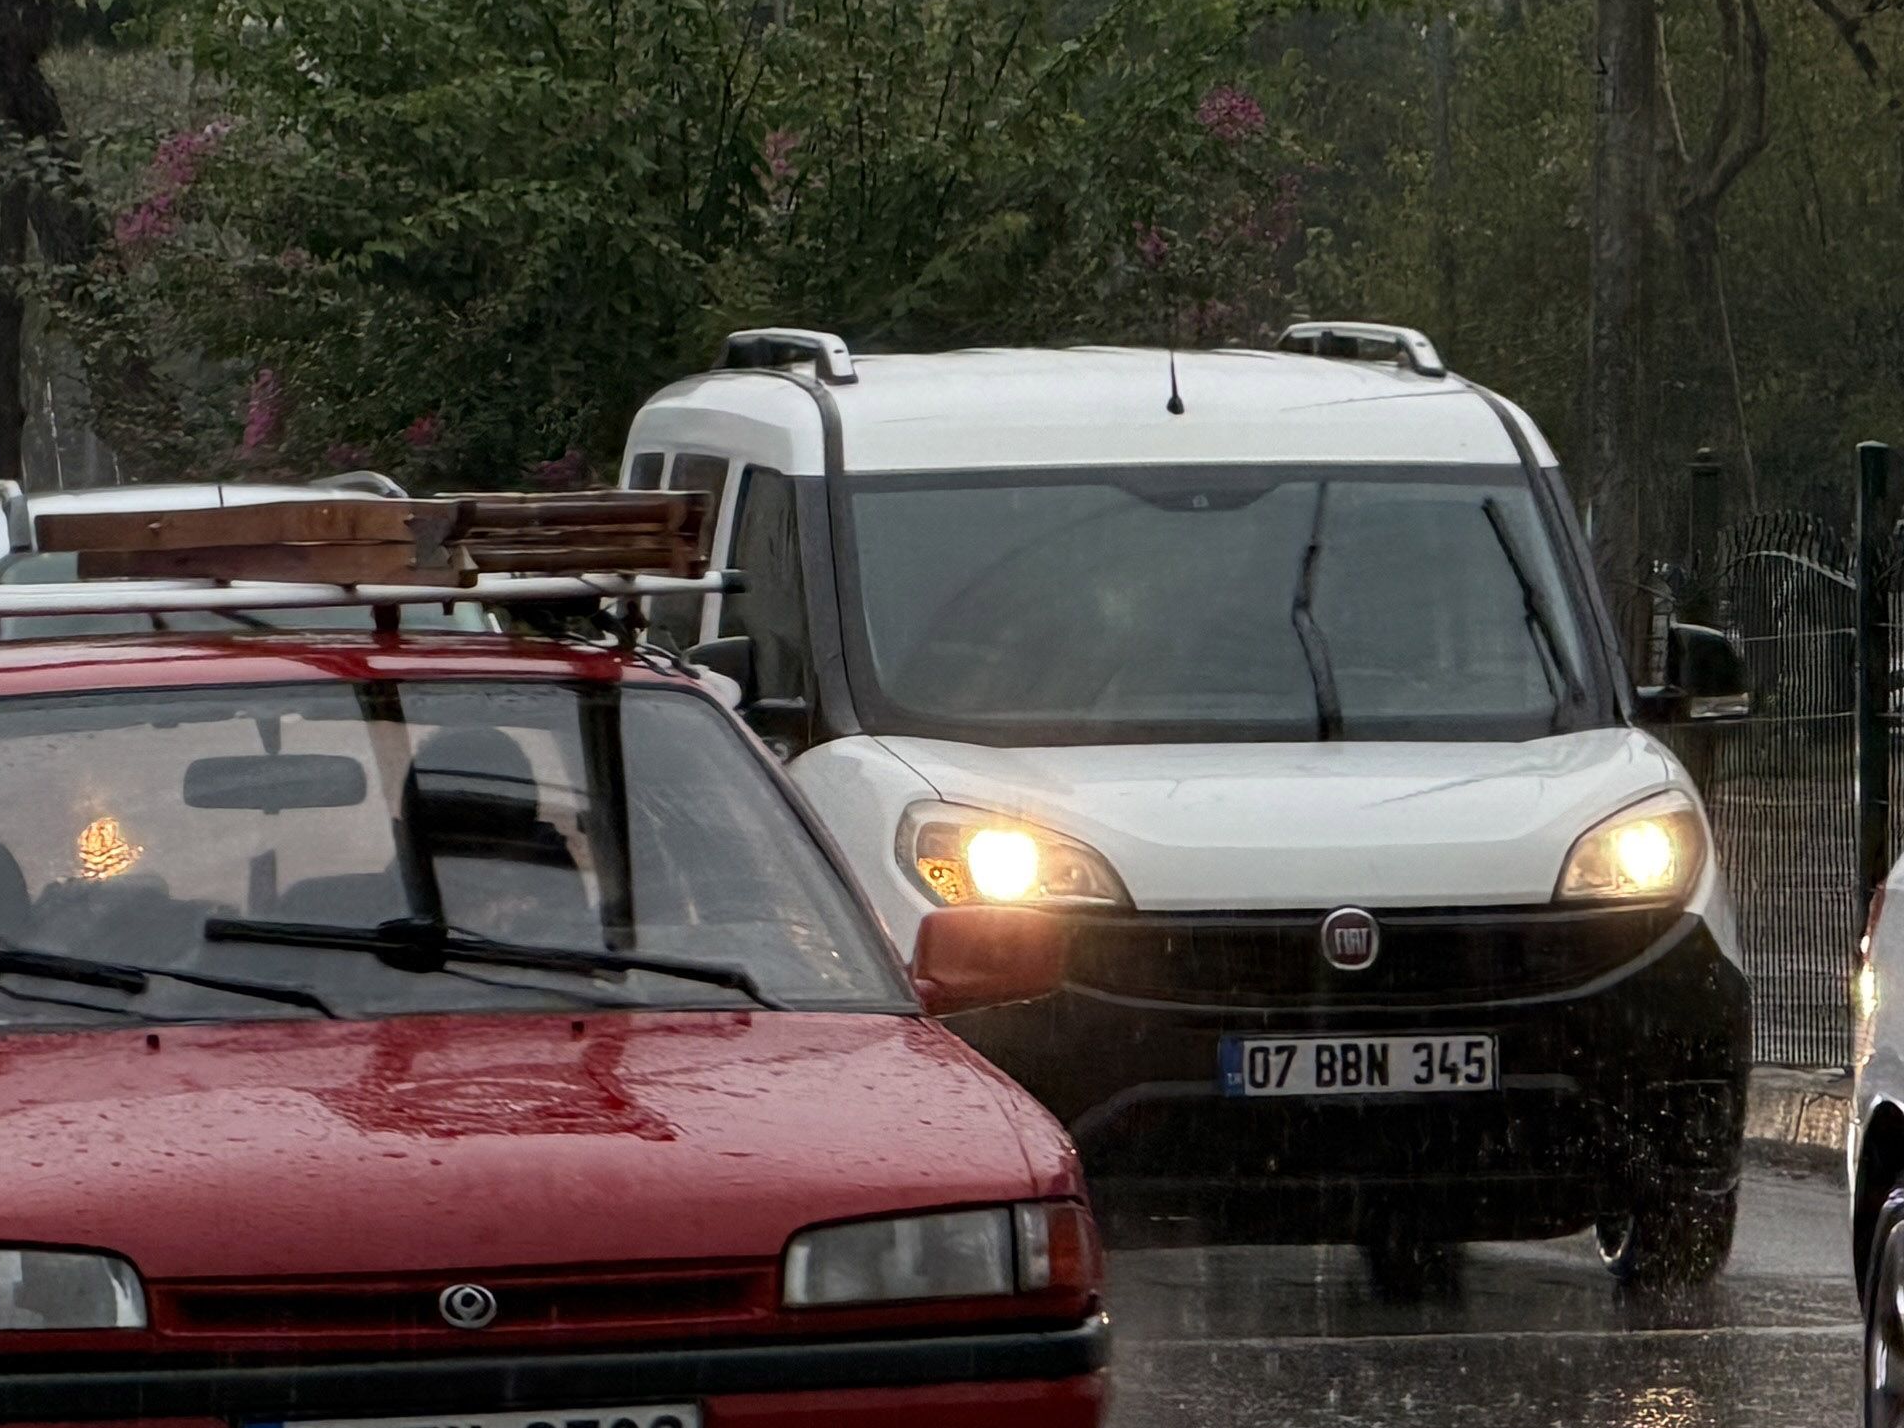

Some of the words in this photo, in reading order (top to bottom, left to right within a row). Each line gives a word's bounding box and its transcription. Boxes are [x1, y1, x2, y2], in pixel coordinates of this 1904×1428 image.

[1248, 1044, 1298, 1089] 07
[1315, 1042, 1390, 1088] BBN
[1412, 1041, 1486, 1085] 345
